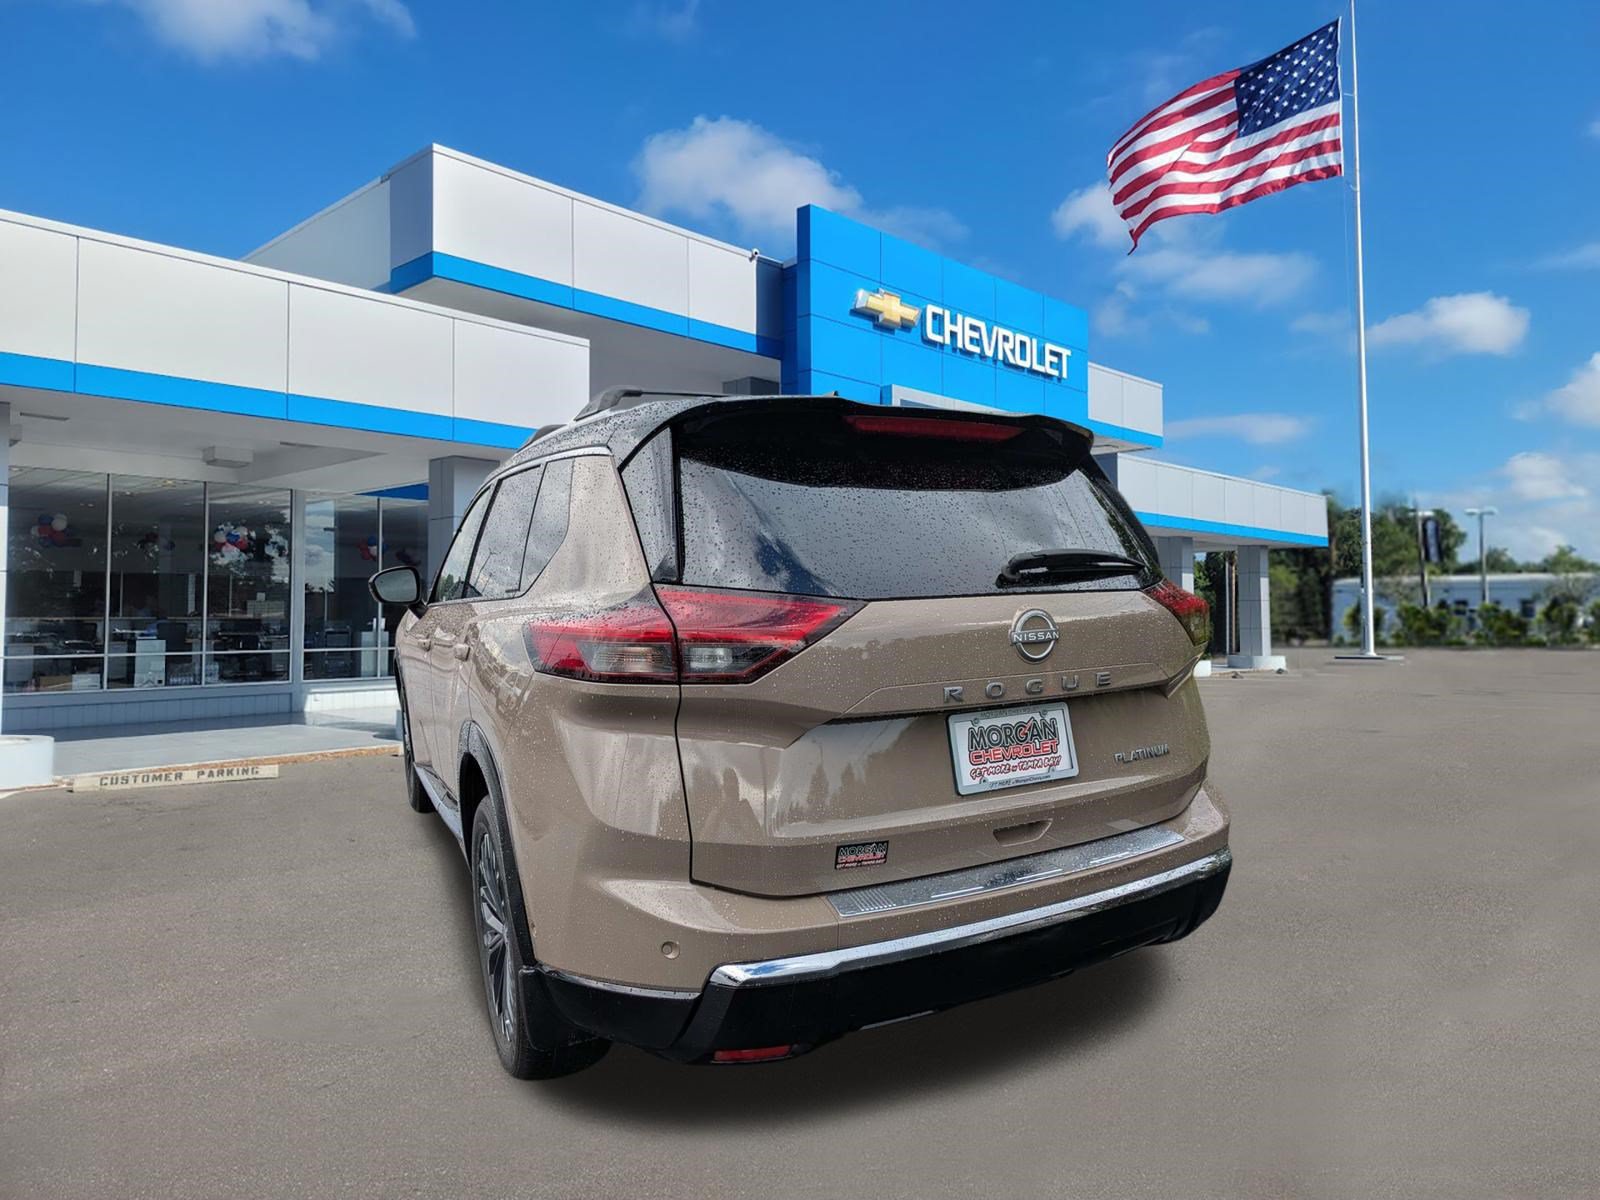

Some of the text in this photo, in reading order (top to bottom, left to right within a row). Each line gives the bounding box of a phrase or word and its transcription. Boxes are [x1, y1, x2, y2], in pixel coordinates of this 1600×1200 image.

[924, 303, 1072, 379] CHEVROLET
[1013, 631, 1059, 642] NISSAN
[943, 671, 1112, 702] ROGUE
[968, 717, 1059, 751] MORGAN
[969, 739, 1059, 766] CHEVROLET
[1113, 744, 1169, 762] PLATINUM
[99, 766, 260, 786] CUSTOMER PARKING
[970, 765, 988, 781] GET
[987, 763, 1011, 776] MORE
[1017, 758, 1044, 771] TAMPA
[839, 843, 888, 856] MORGAN
